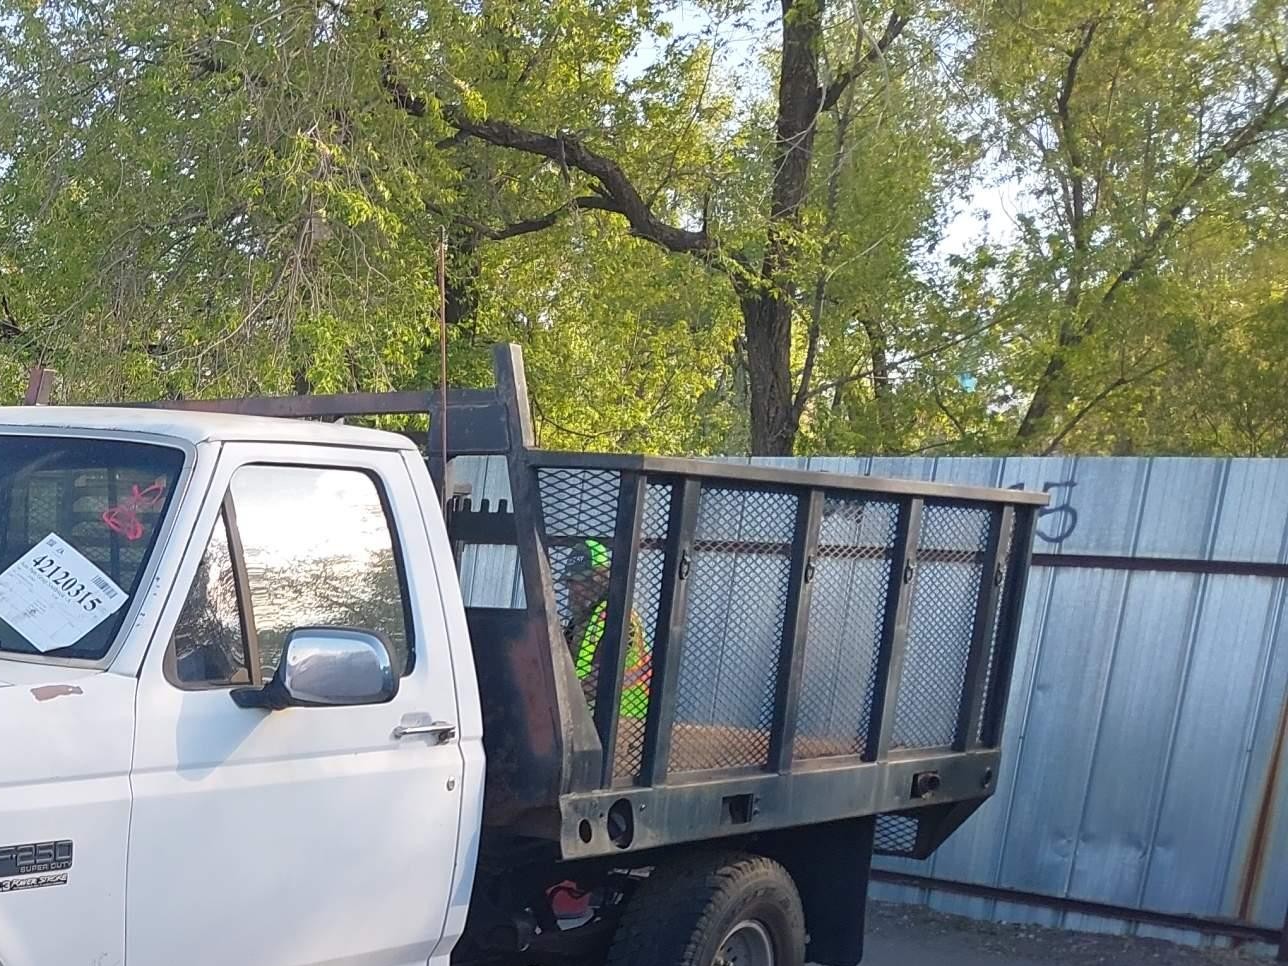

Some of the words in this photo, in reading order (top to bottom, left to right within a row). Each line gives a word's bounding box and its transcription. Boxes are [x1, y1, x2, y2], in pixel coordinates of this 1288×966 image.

[32, 554, 103, 612] 42120315
[19, 864, 49, 873] SUPER
[50, 861, 72, 870] DUTY
[11, 877, 38, 888] POWER
